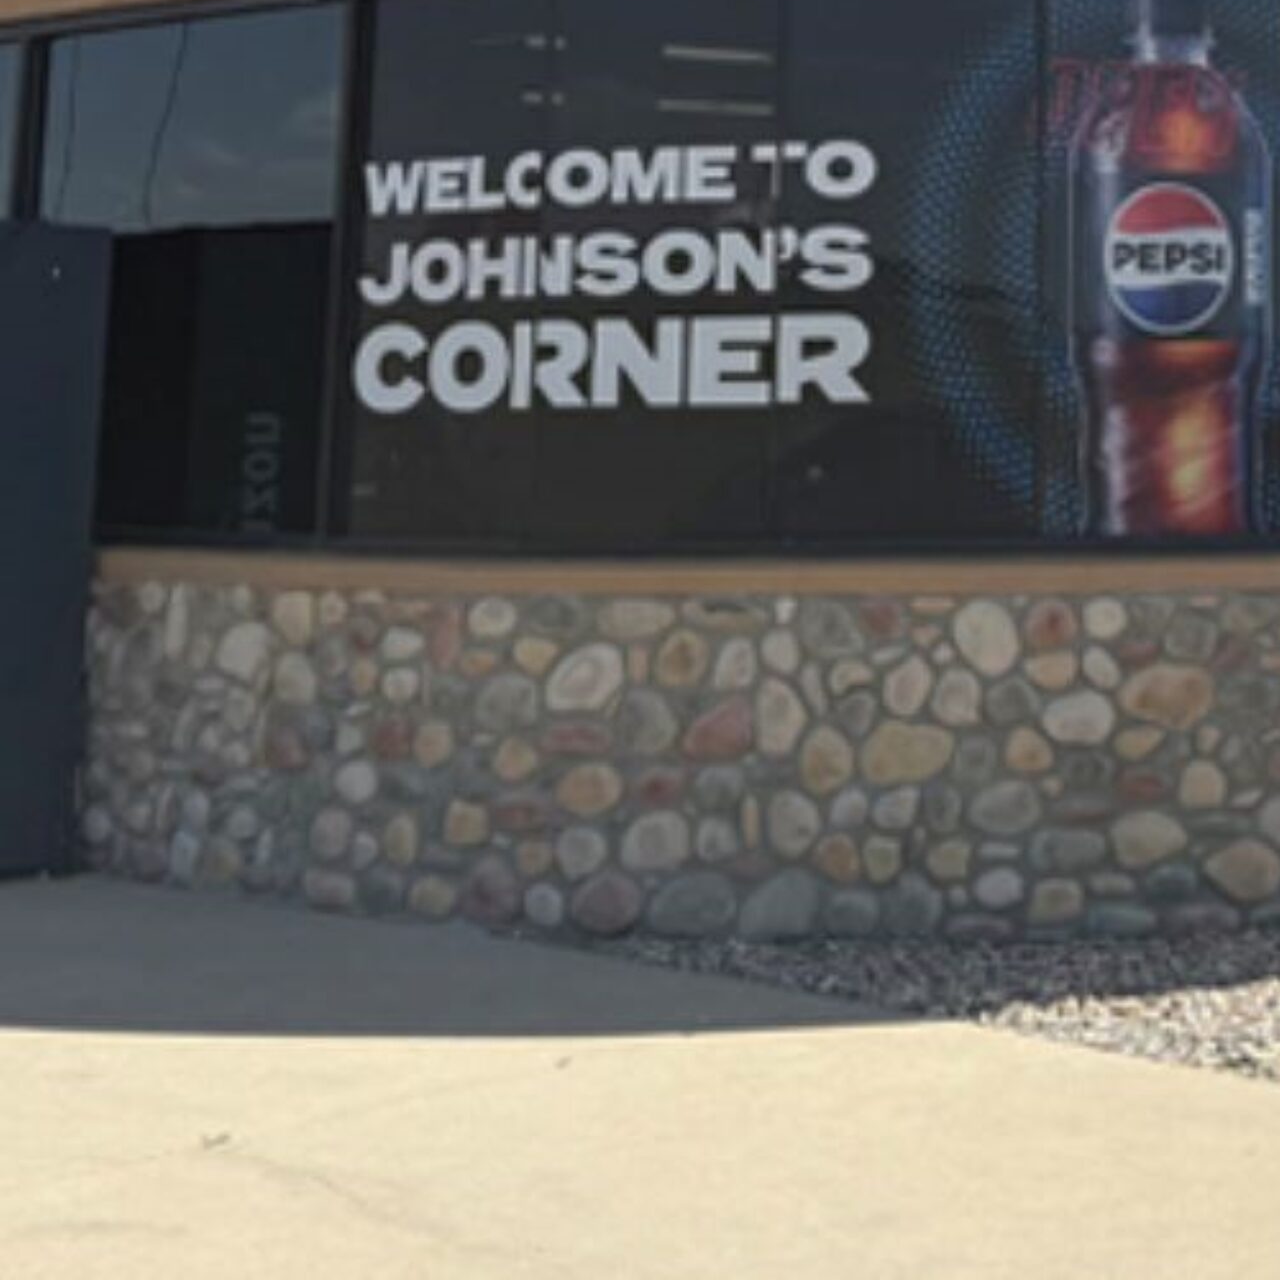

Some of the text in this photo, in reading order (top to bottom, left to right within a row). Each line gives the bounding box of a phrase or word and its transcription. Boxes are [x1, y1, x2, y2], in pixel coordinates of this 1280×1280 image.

[365, 139, 877, 216] WELCOME TO
[358, 224, 874, 306] JOHNSON'S
[1112, 241, 1228, 275] PEPSI
[354, 311, 873, 414] CORNER
